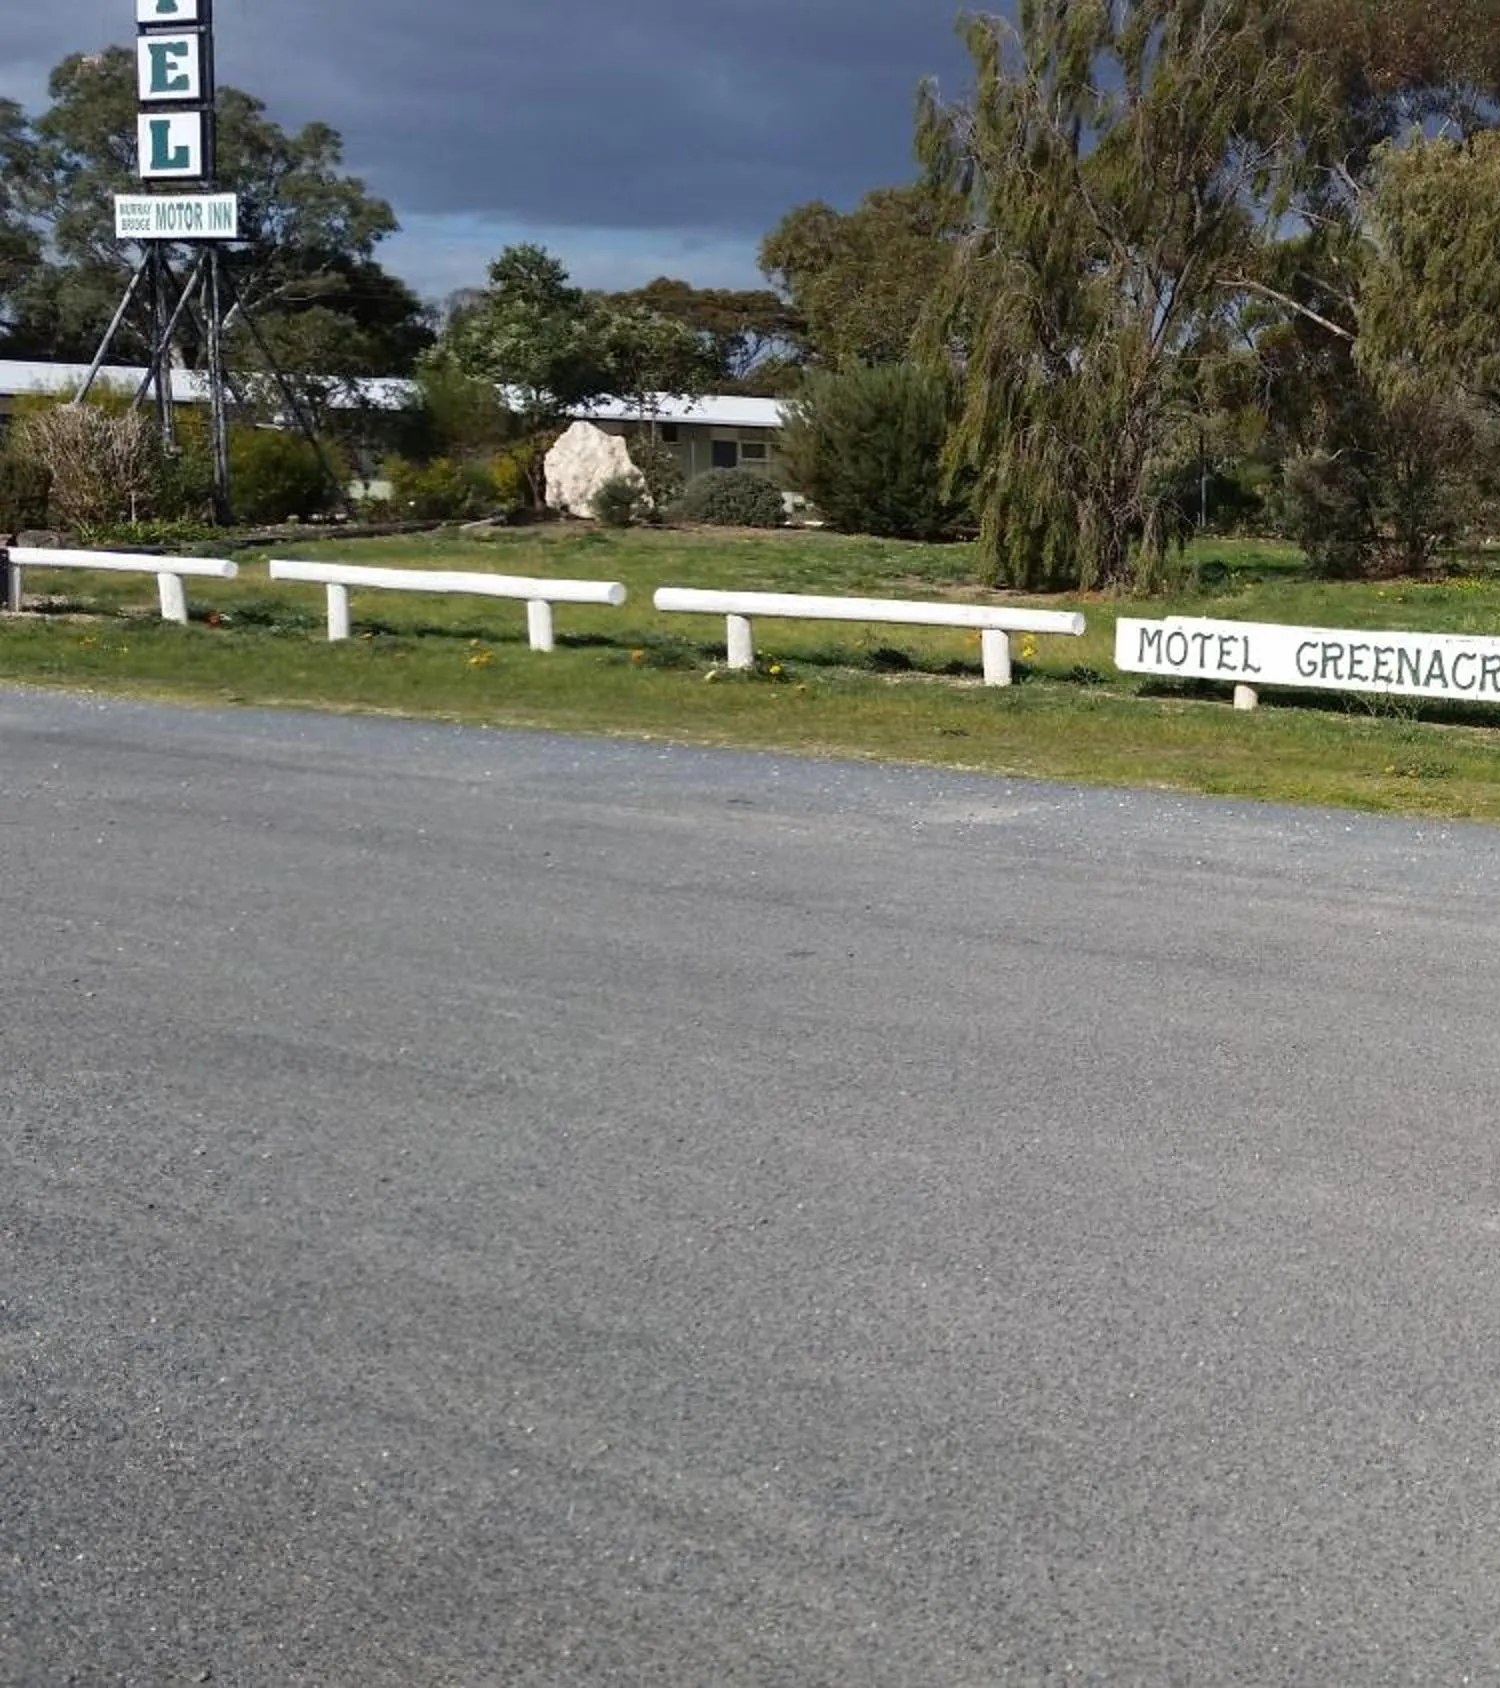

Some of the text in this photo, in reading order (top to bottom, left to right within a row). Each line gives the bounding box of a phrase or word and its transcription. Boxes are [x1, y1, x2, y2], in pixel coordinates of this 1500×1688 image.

[155, 202, 232, 231] MOTOR INN
[1136, 626, 1262, 674] MOTEL
